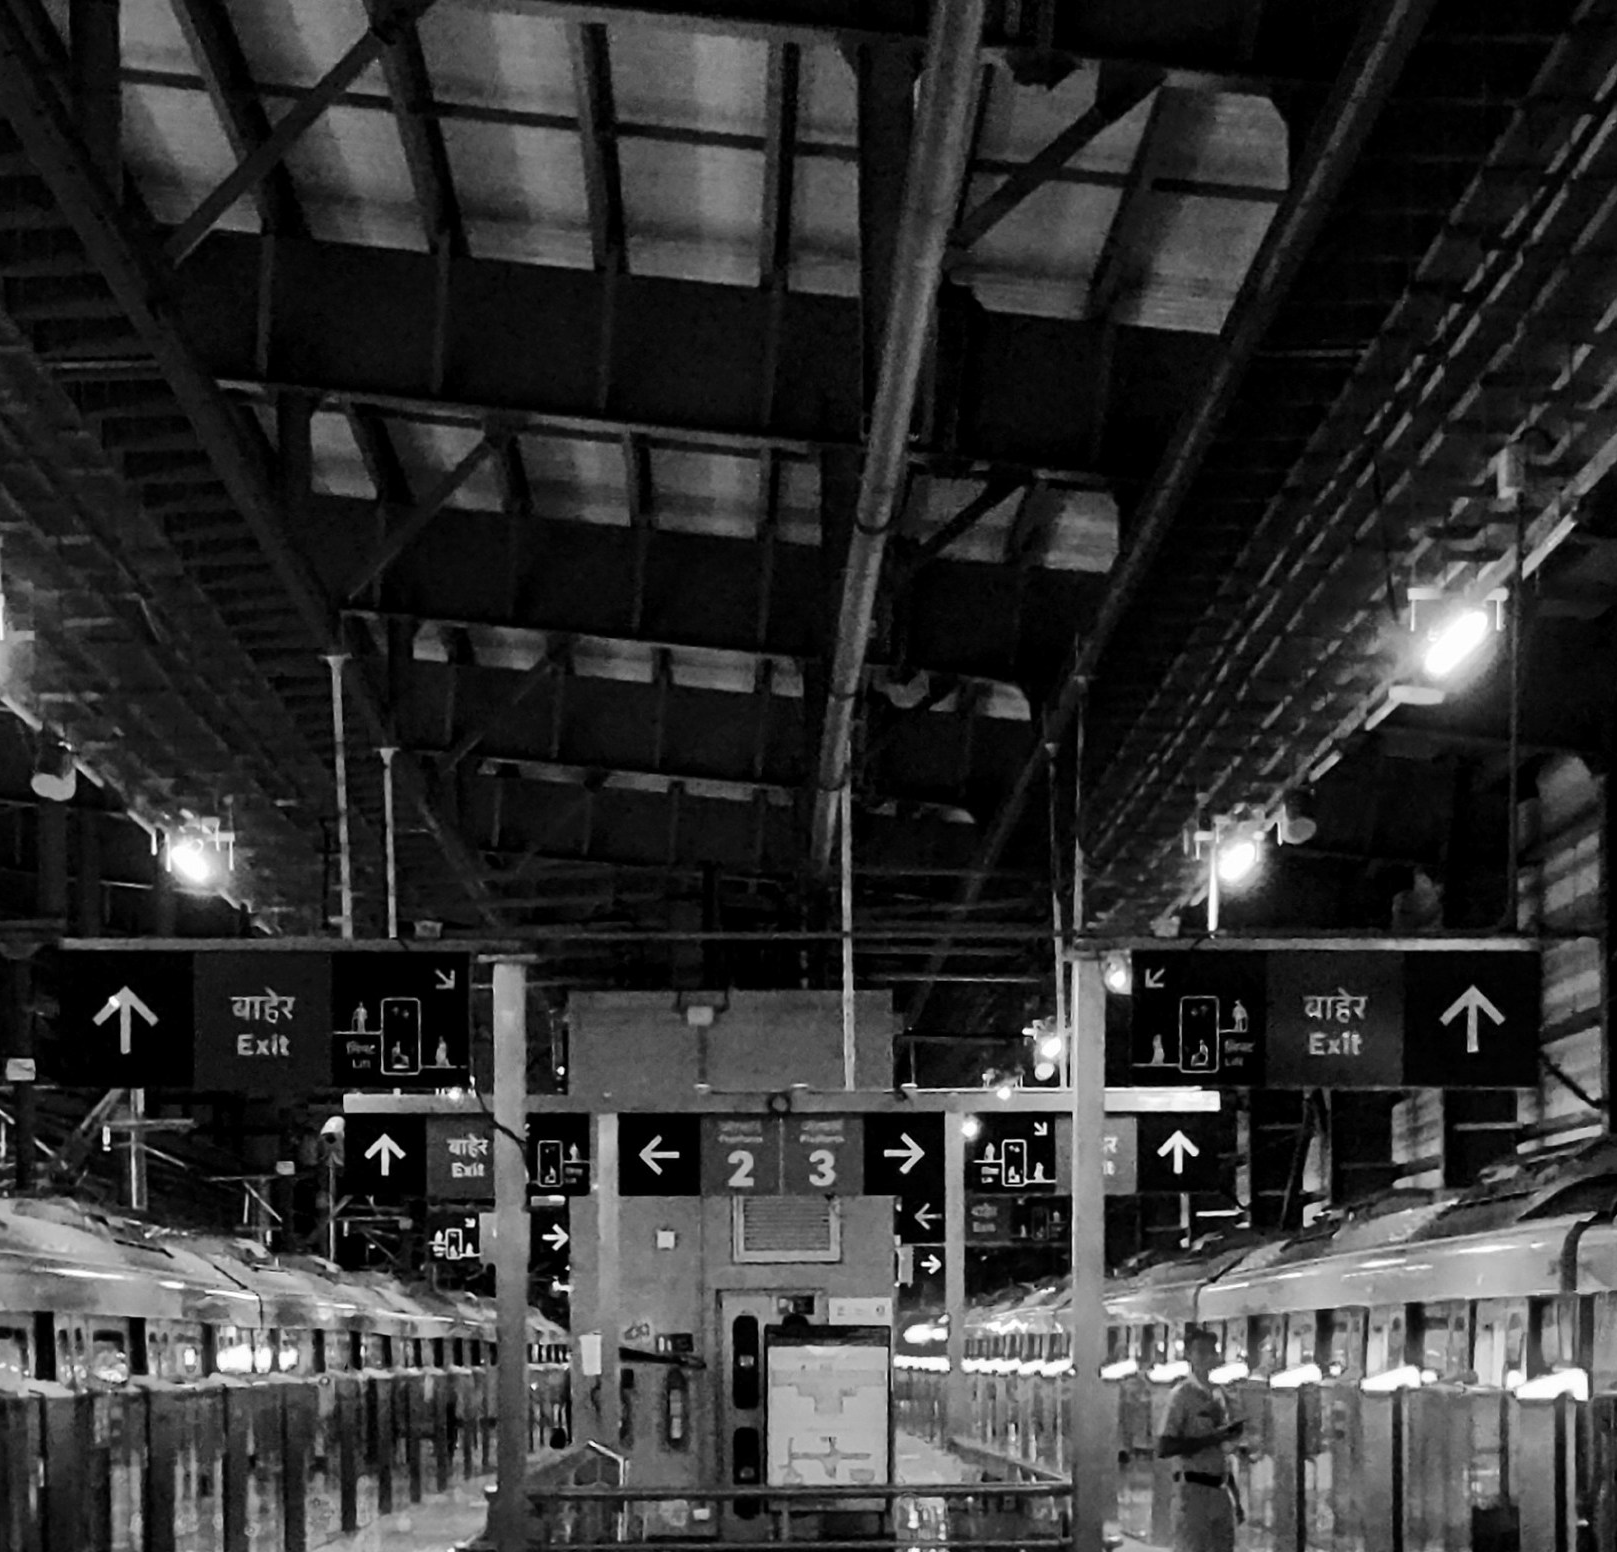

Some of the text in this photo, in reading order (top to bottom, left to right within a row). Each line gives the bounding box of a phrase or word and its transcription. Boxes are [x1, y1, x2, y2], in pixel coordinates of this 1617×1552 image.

[229, 987, 296, 1025] बाहेर
[1303, 986, 1369, 1024] बाहेर
[236, 1033, 290, 1057] Exit
[1308, 1030, 1363, 1056] Exit
[451, 1161, 485, 1178] Exit
[727, 1150, 755, 1187] 2
[809, 1149, 837, 1187] 3
